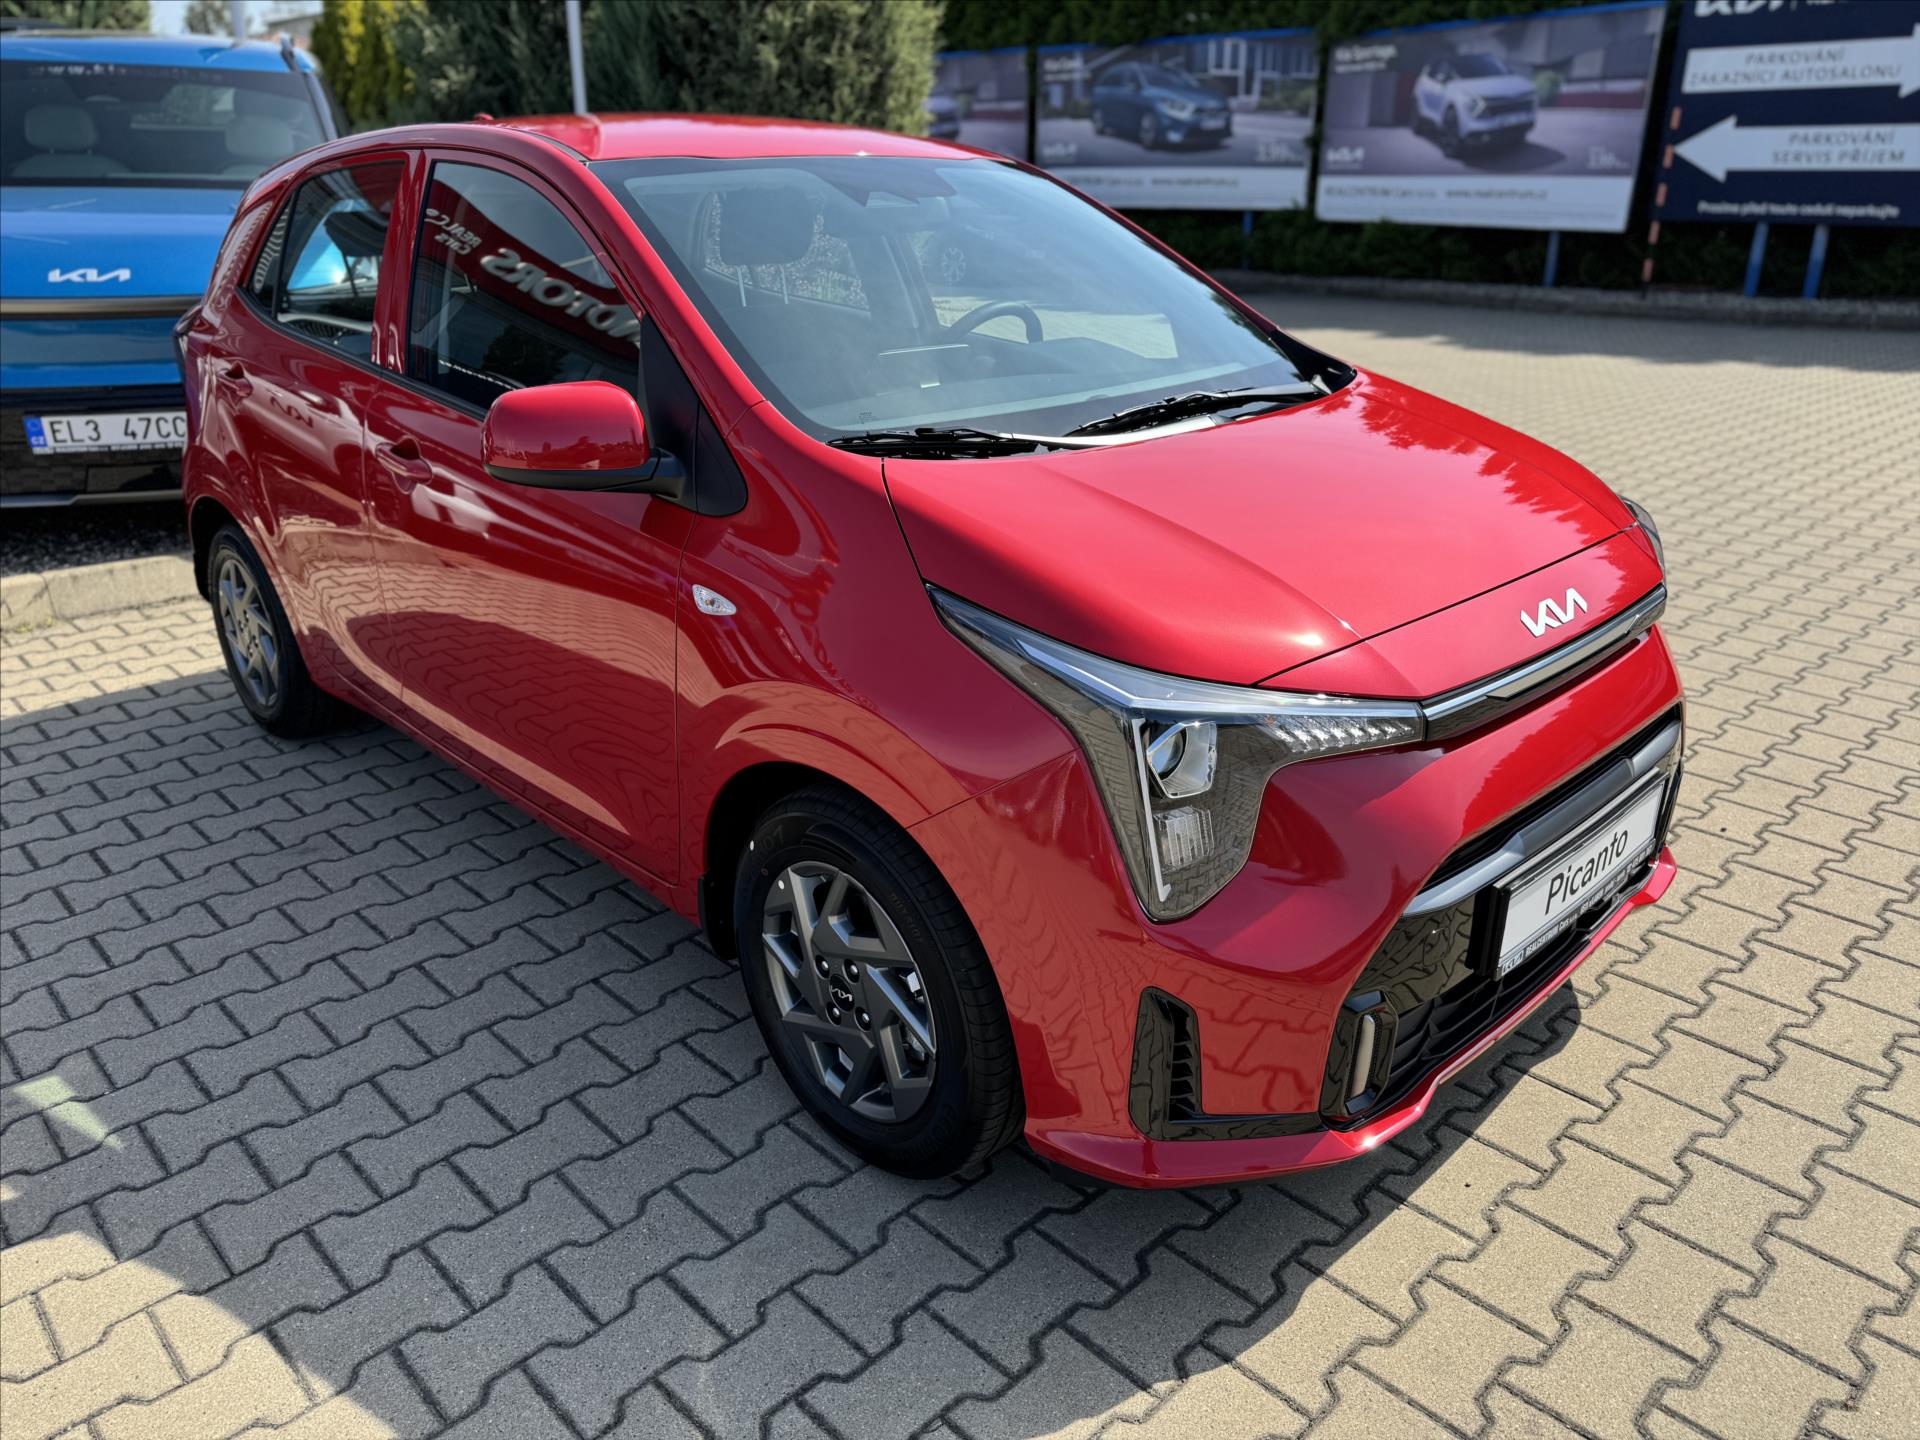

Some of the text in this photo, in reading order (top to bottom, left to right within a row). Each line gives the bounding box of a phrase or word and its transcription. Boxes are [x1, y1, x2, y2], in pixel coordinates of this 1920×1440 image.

[1773, 150, 1832, 165] SERVIS
[31, 436, 46, 446] CZ
[50, 419, 101, 444] EL3
[1520, 587, 1588, 638] KIA
[1544, 828, 1629, 916] Picanto
